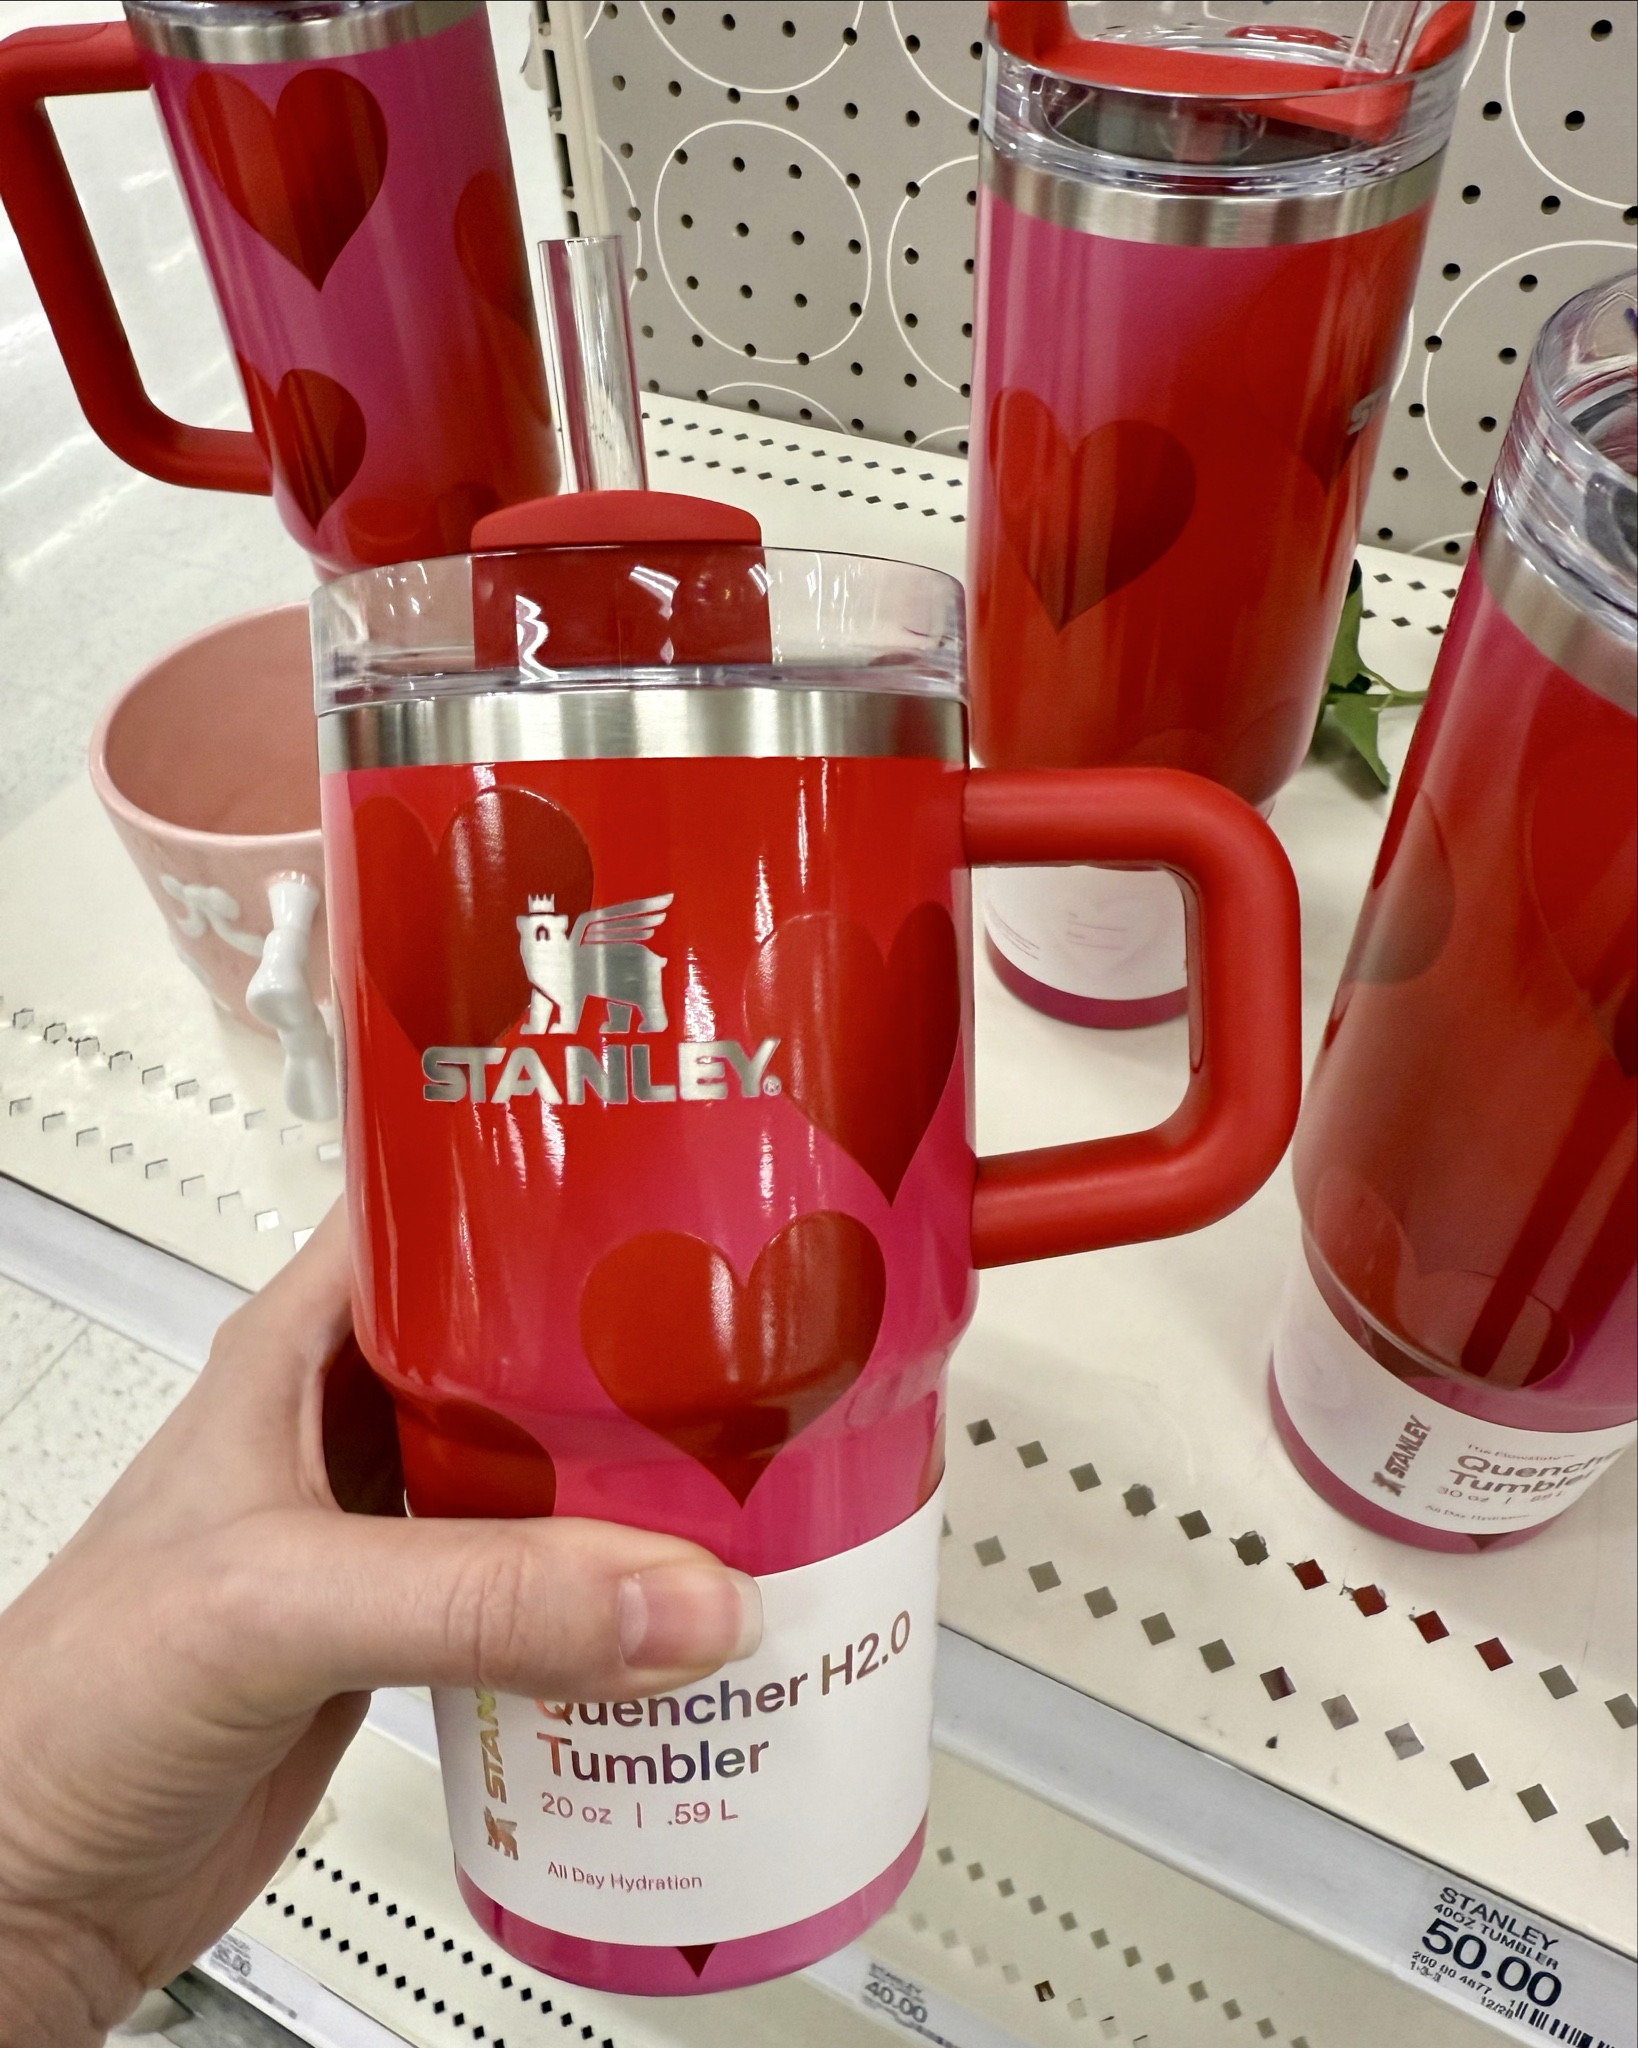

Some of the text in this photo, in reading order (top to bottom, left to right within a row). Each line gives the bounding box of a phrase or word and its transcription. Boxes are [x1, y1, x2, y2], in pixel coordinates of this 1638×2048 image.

[1384, 1414, 1432, 1479] STANLEY
[1457, 1446, 1623, 1475] Quench
[536, 1610, 911, 1727] Quencher H2.0
[474, 1687, 508, 1804] STAN
[537, 1732, 769, 1785] Tumbler
[542, 1791, 574, 1818] 20
[582, 1806, 612, 1825] oz
[667, 1801, 711, 1826] .59
[720, 1798, 739, 1821] L
[548, 1861, 703, 1893] All Day Hydration
[1440, 1886, 1559, 1951] STANLEY
[1422, 1918, 1562, 2007] 50.00
[1480, 1923, 1560, 1971] TUMBLER
[864, 1981, 928, 2024] 40.00
